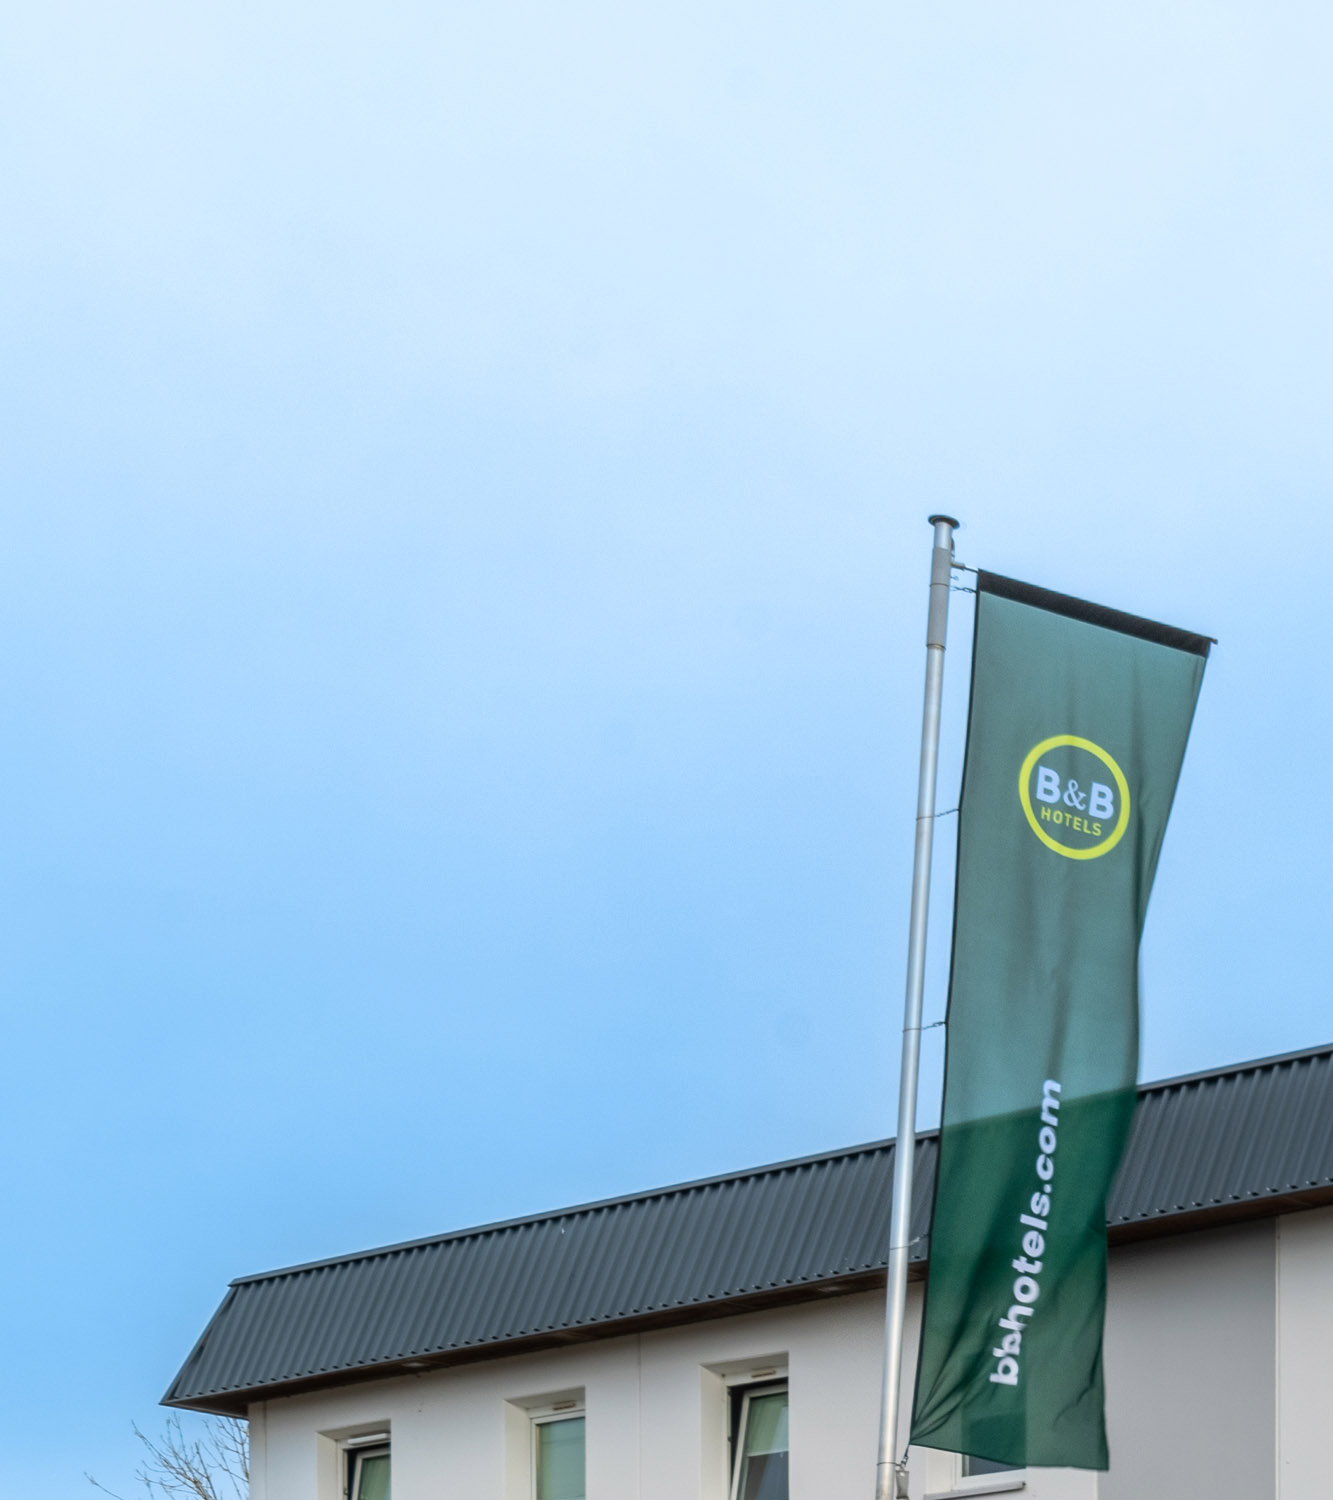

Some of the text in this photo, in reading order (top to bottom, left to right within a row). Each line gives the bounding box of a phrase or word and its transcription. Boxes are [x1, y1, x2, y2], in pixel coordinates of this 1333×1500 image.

[1036, 765, 1115, 820] B&B
[1040, 807, 1103, 837] HOTELS
[989, 1079, 1062, 1386] bbhotels.com
